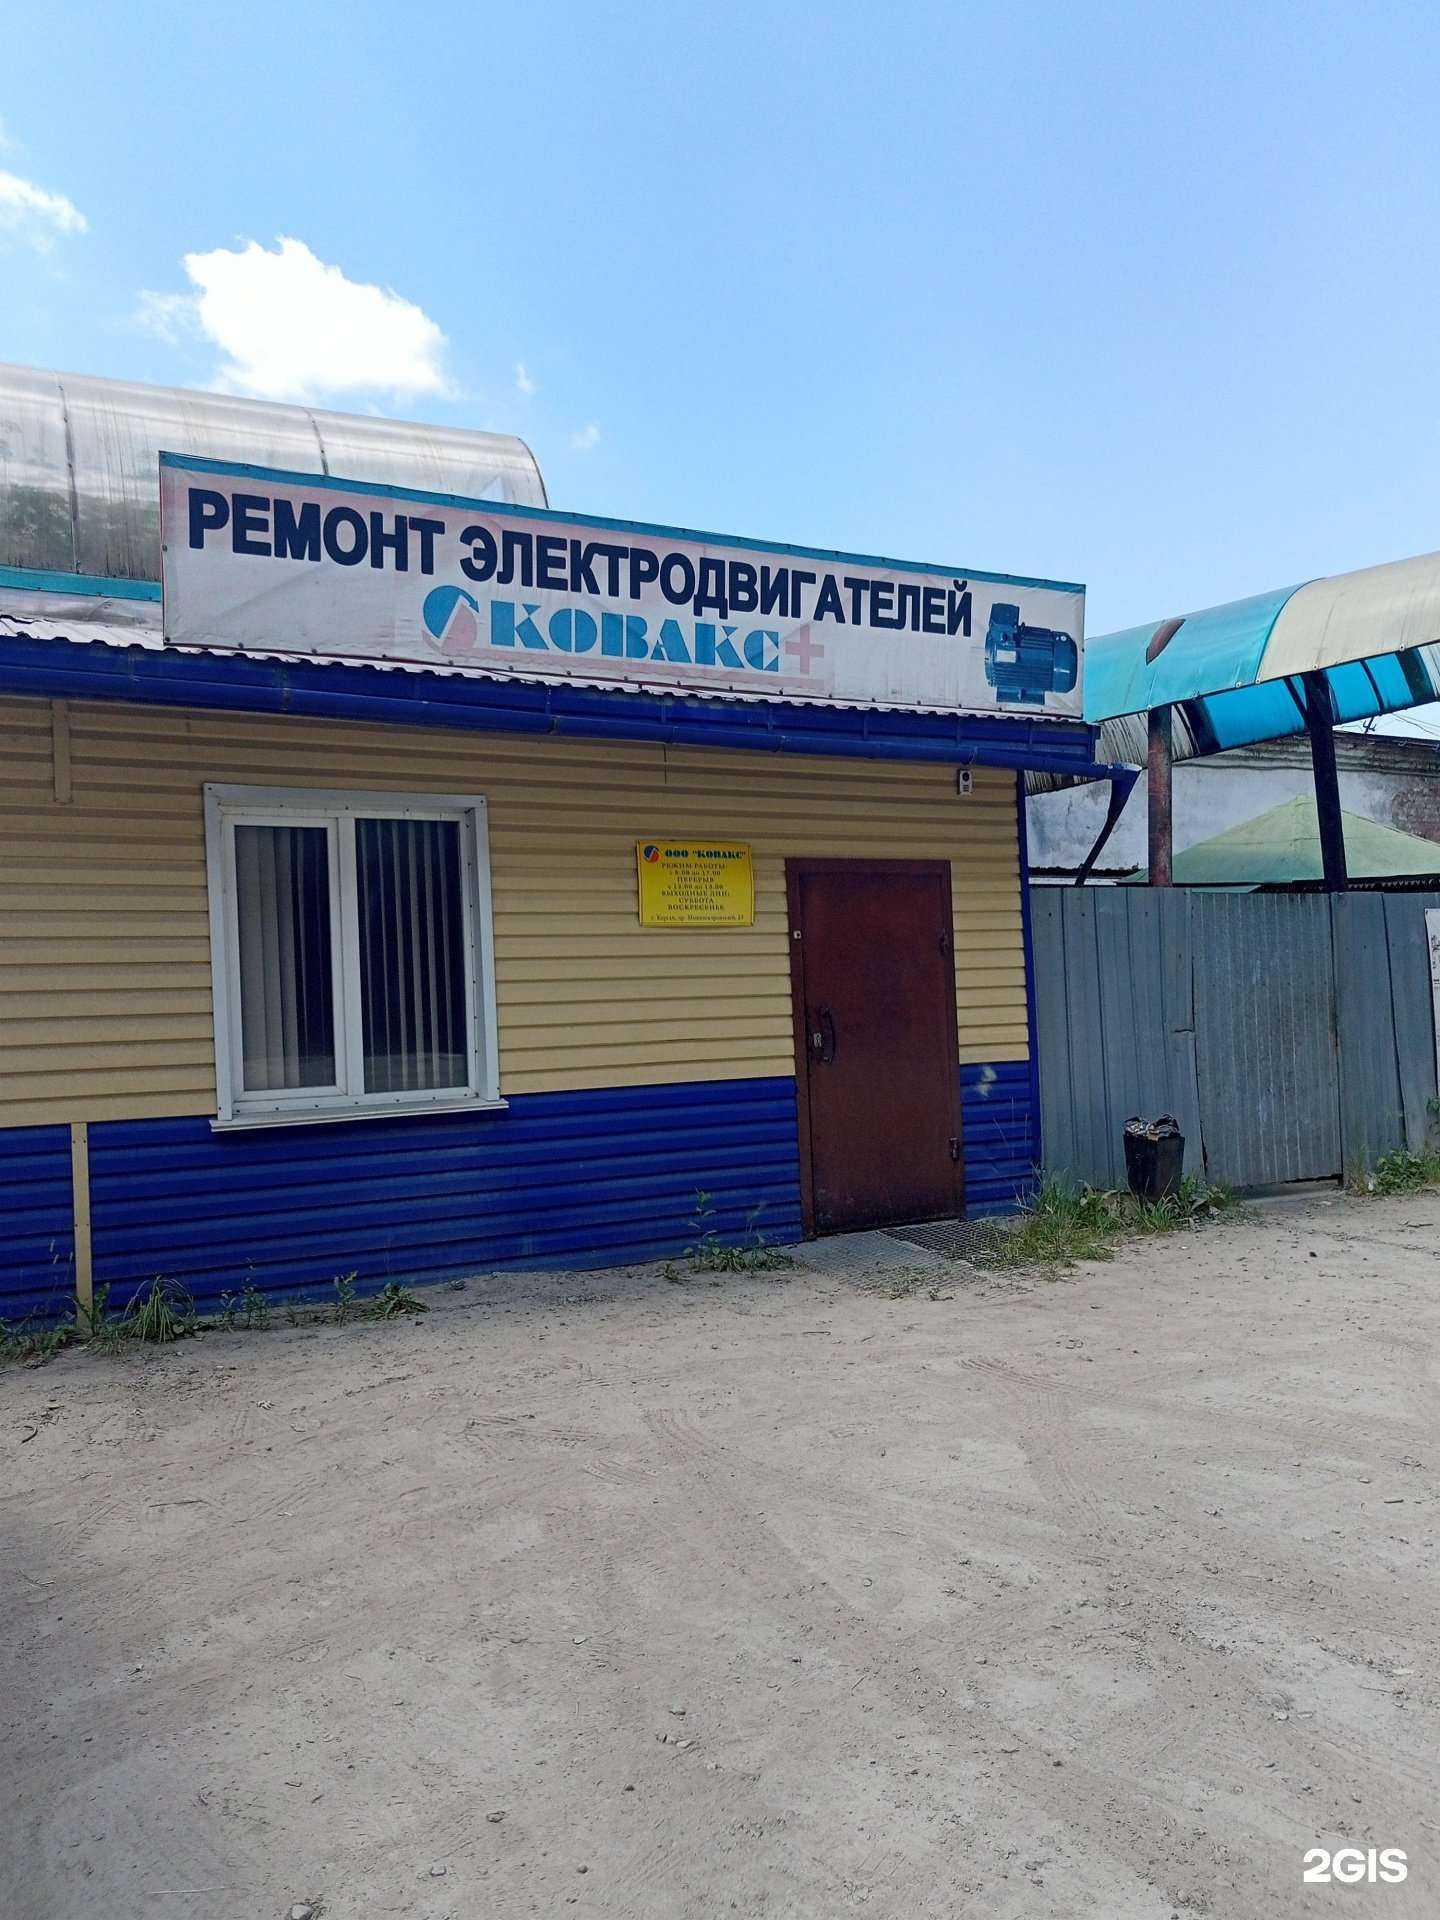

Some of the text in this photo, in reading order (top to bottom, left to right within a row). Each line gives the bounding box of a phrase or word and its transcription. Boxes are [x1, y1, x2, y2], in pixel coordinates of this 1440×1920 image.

[188, 487, 973, 638] РЕМОНТ ЭЛЕКТРОДВИГАТЕЛЕЙ
[664, 848, 689, 858] ООО
